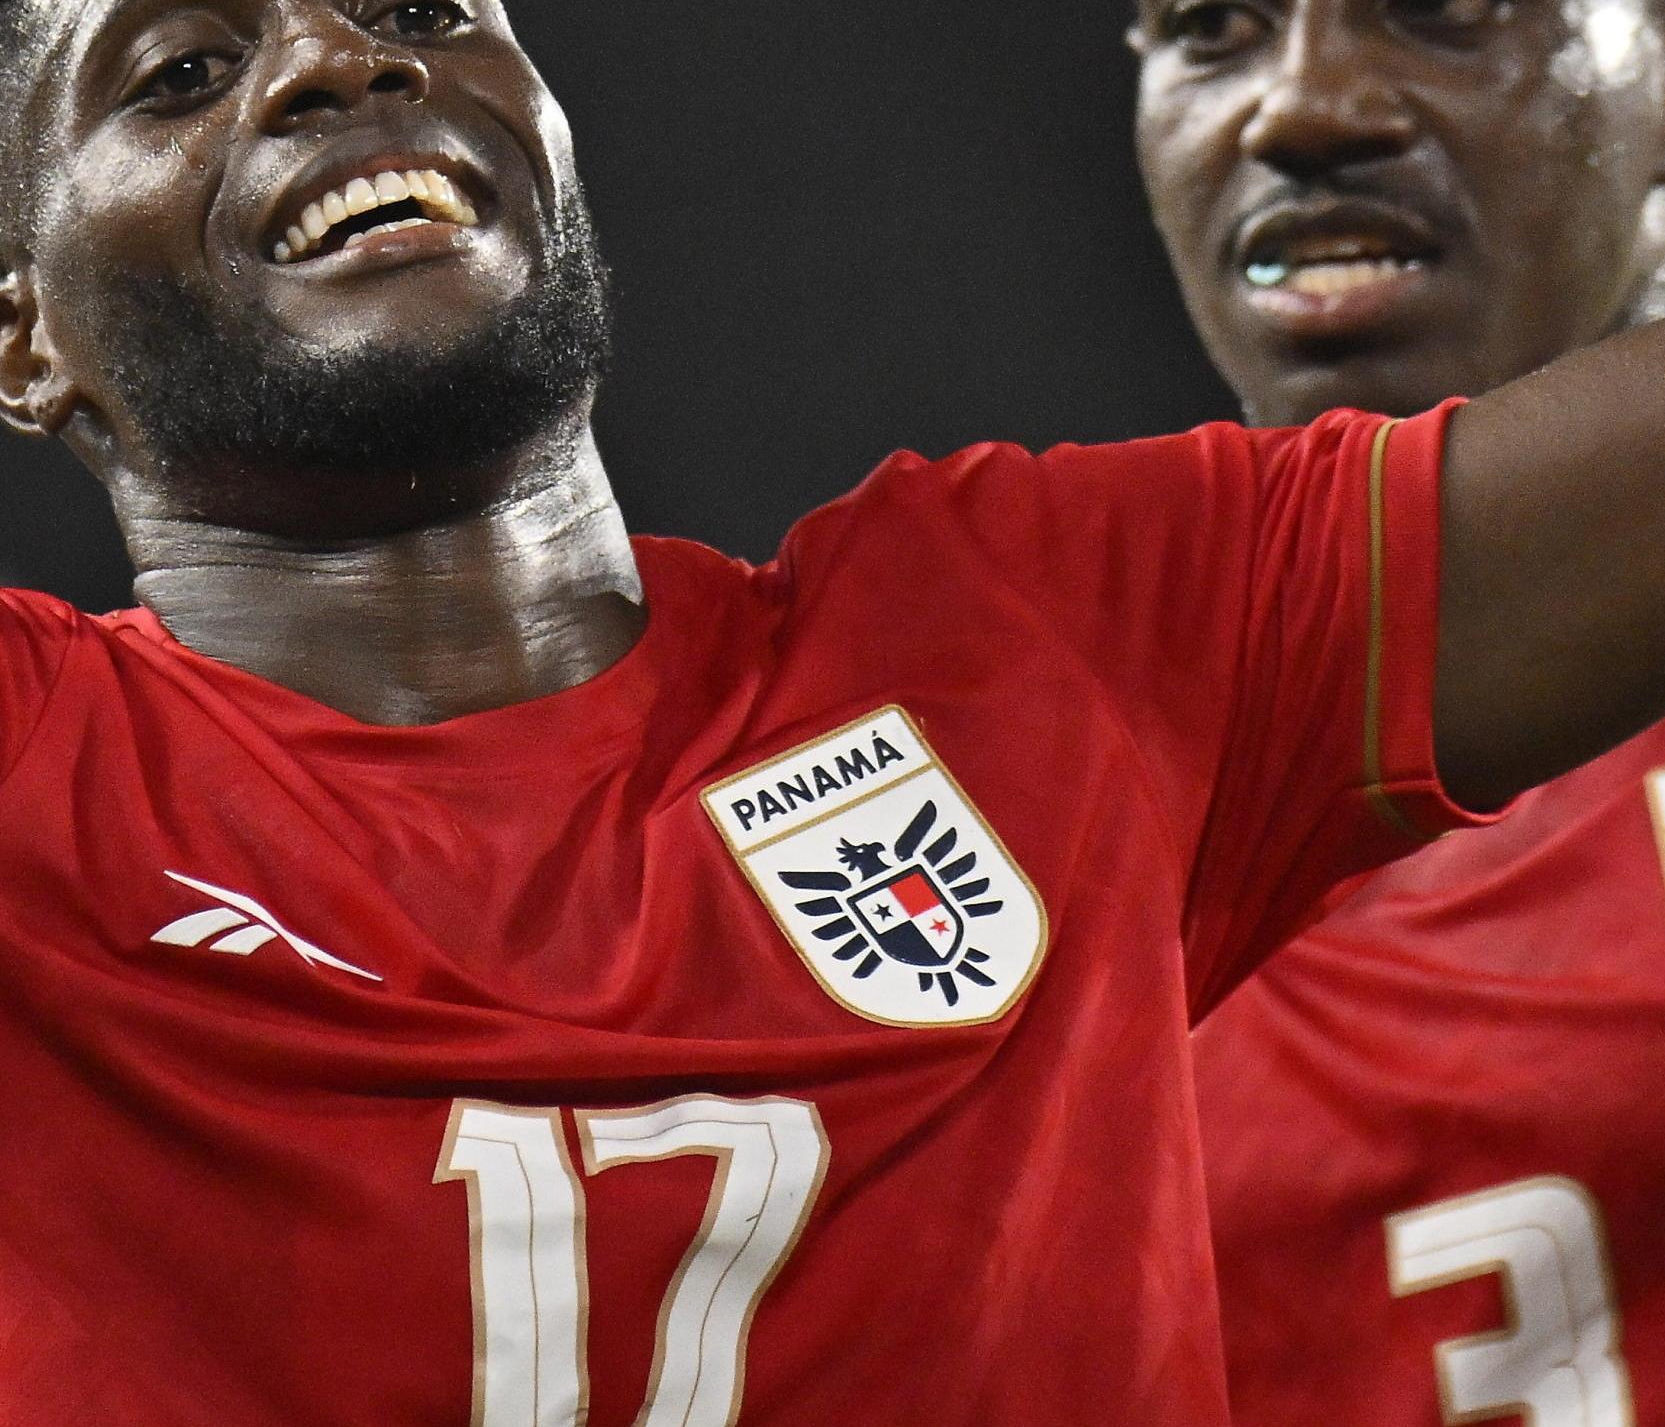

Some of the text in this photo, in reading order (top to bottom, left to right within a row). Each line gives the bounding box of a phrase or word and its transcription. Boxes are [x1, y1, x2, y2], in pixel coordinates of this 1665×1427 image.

[731, 730, 905, 831] PANAMÁ
[432, 1093, 832, 1427] 17
[1383, 1174, 1637, 1427] 3
